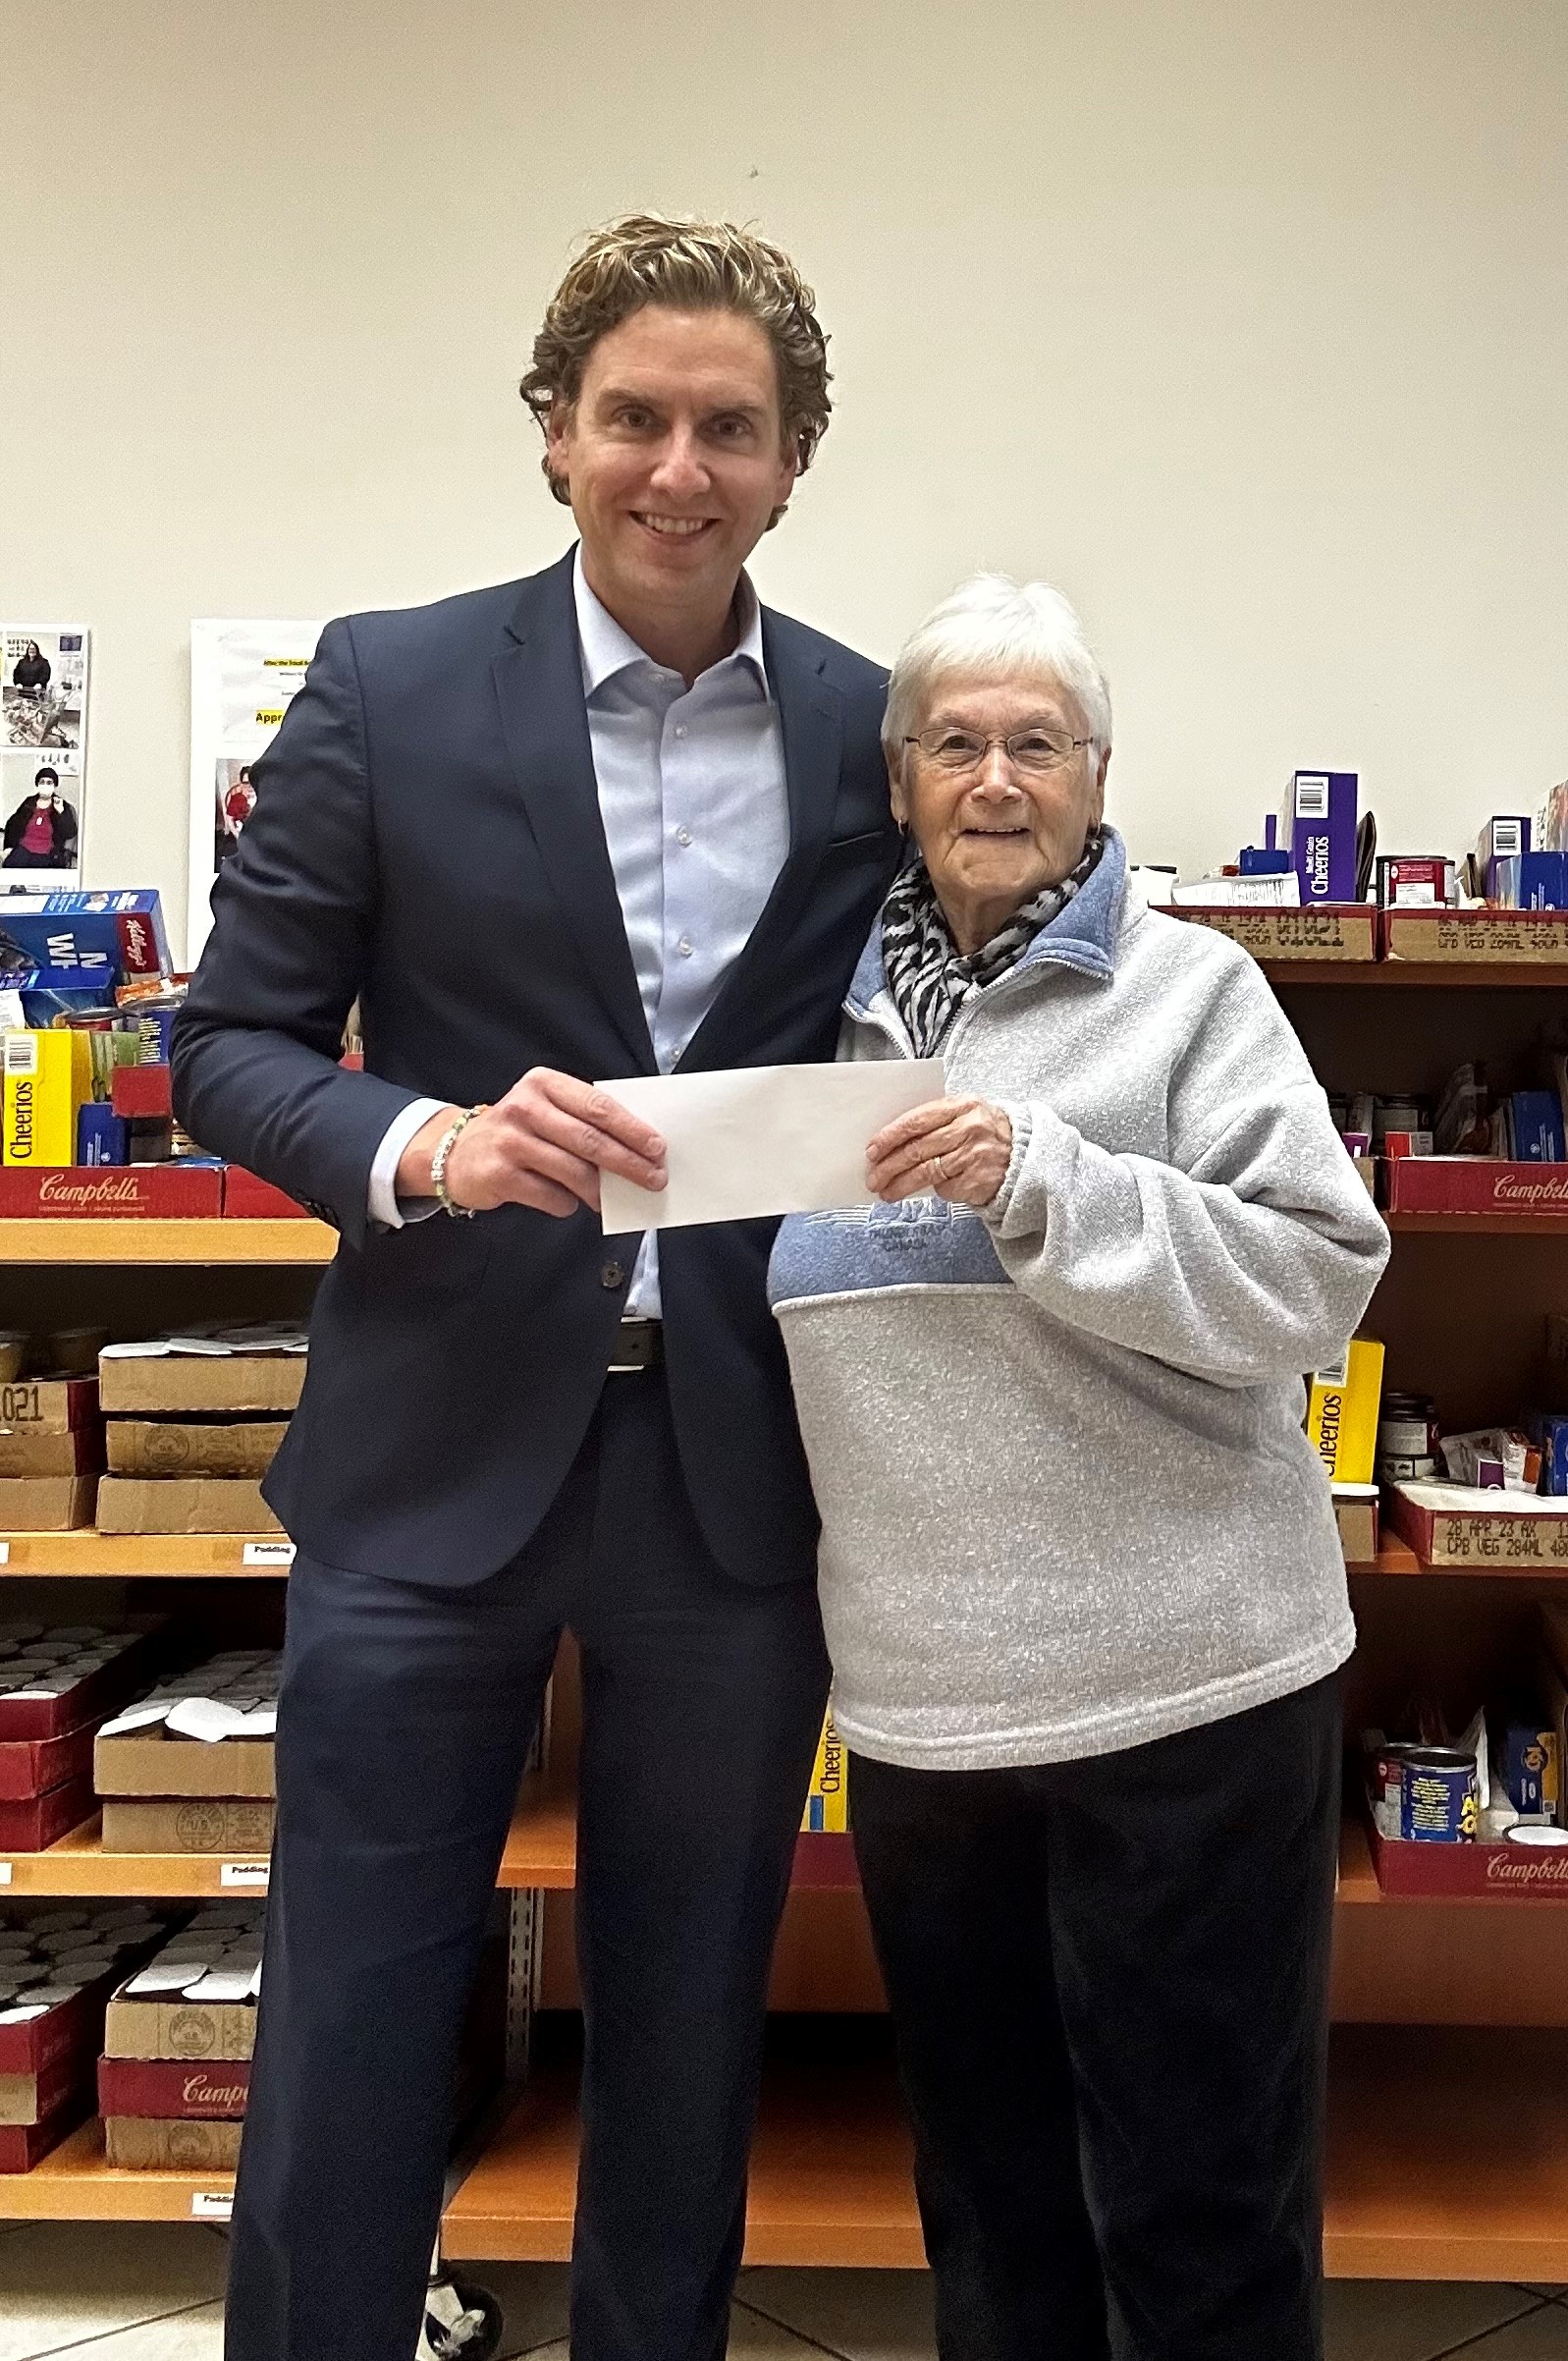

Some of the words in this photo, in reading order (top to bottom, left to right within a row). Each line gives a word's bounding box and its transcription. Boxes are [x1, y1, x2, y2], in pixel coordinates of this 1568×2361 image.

[1310, 836, 1328, 894] Cheerios
[9, 1081, 32, 1159] Cheerios
[0, 1387, 44, 1421] 021
